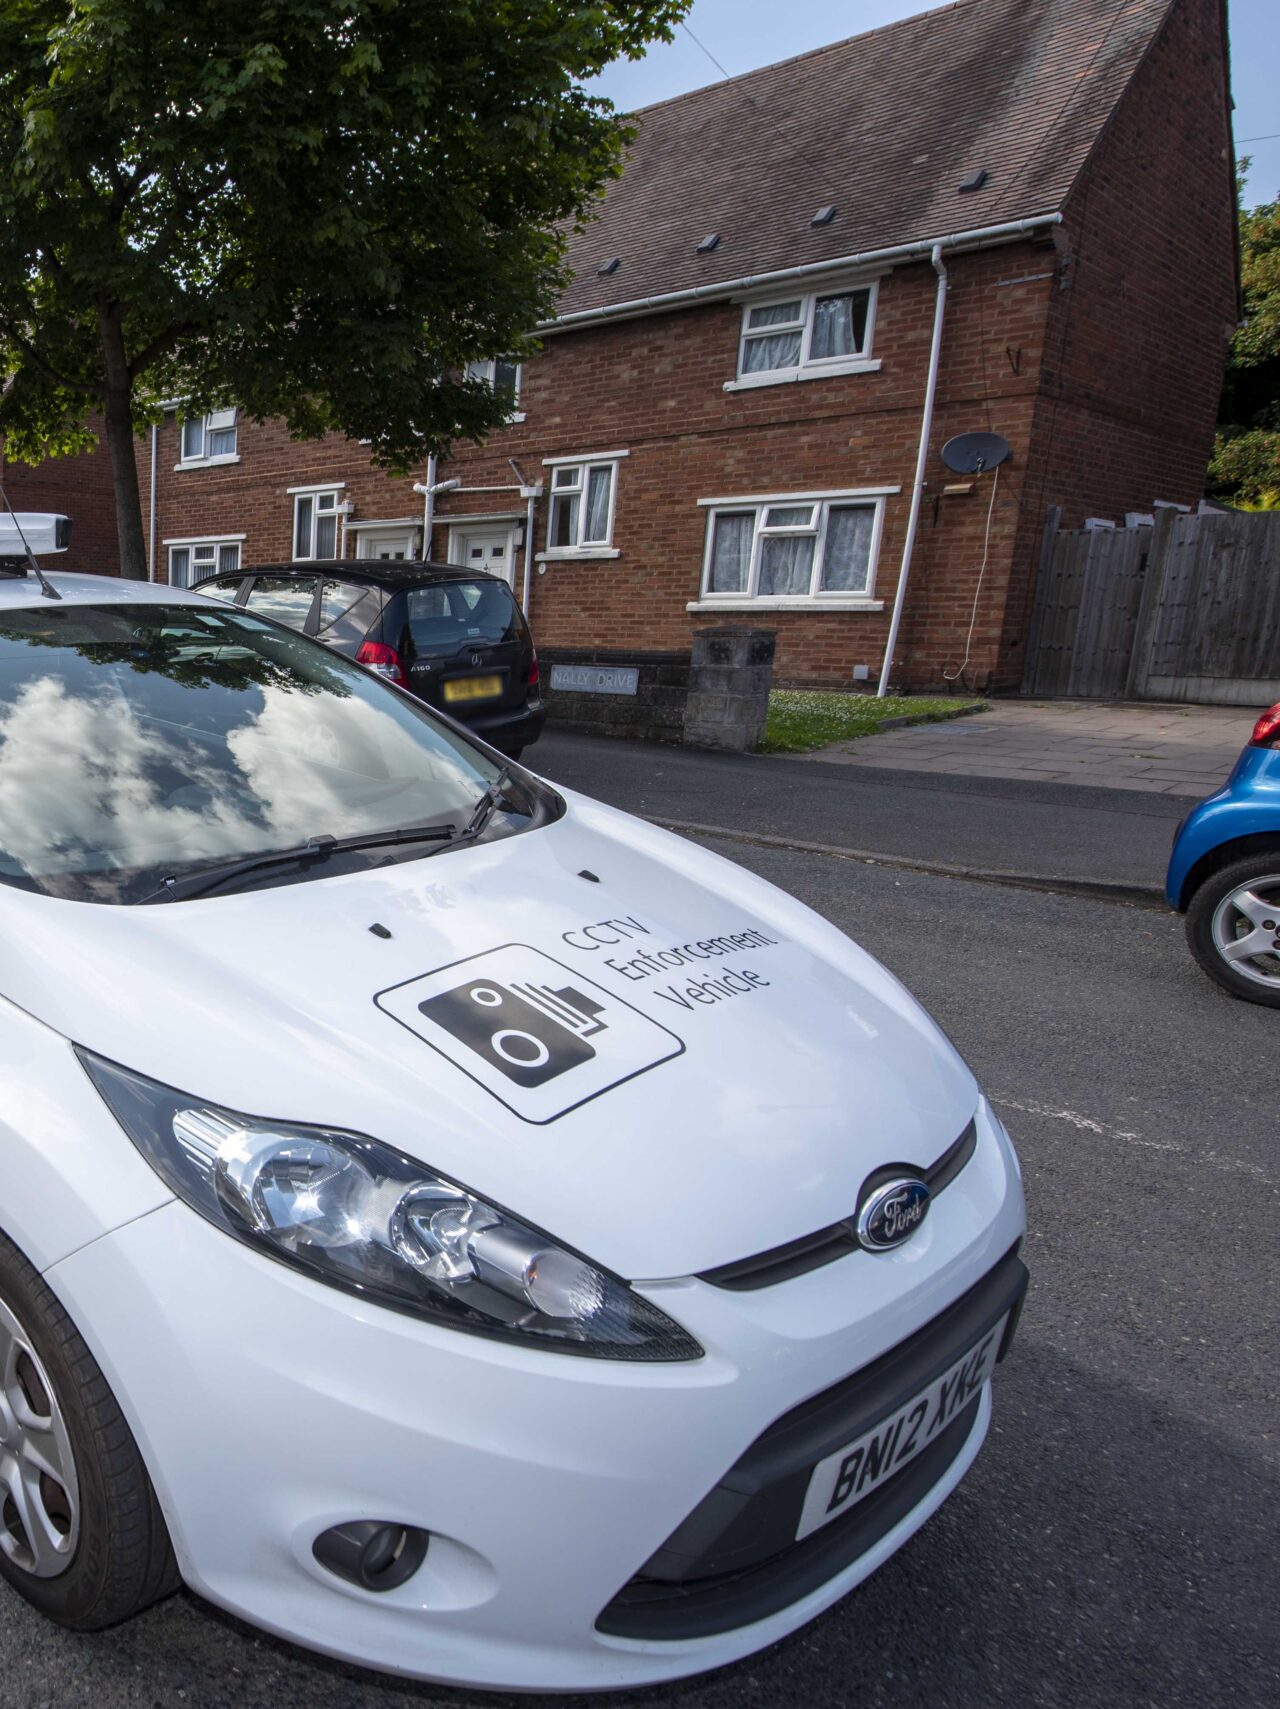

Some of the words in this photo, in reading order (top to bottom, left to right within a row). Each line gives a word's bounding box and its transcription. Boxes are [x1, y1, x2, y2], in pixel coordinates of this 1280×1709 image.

[553, 671, 590, 686] NALLY
[597, 673, 634, 688] DRIVE
[561, 915, 652, 951] CCTV
[603, 927, 779, 982] Enforcement
[653, 966, 771, 1012] Vehicle
[883, 1191, 922, 1238] Ford
[825, 1398, 929, 1514] BN12
[926, 1331, 996, 1438] XKE
